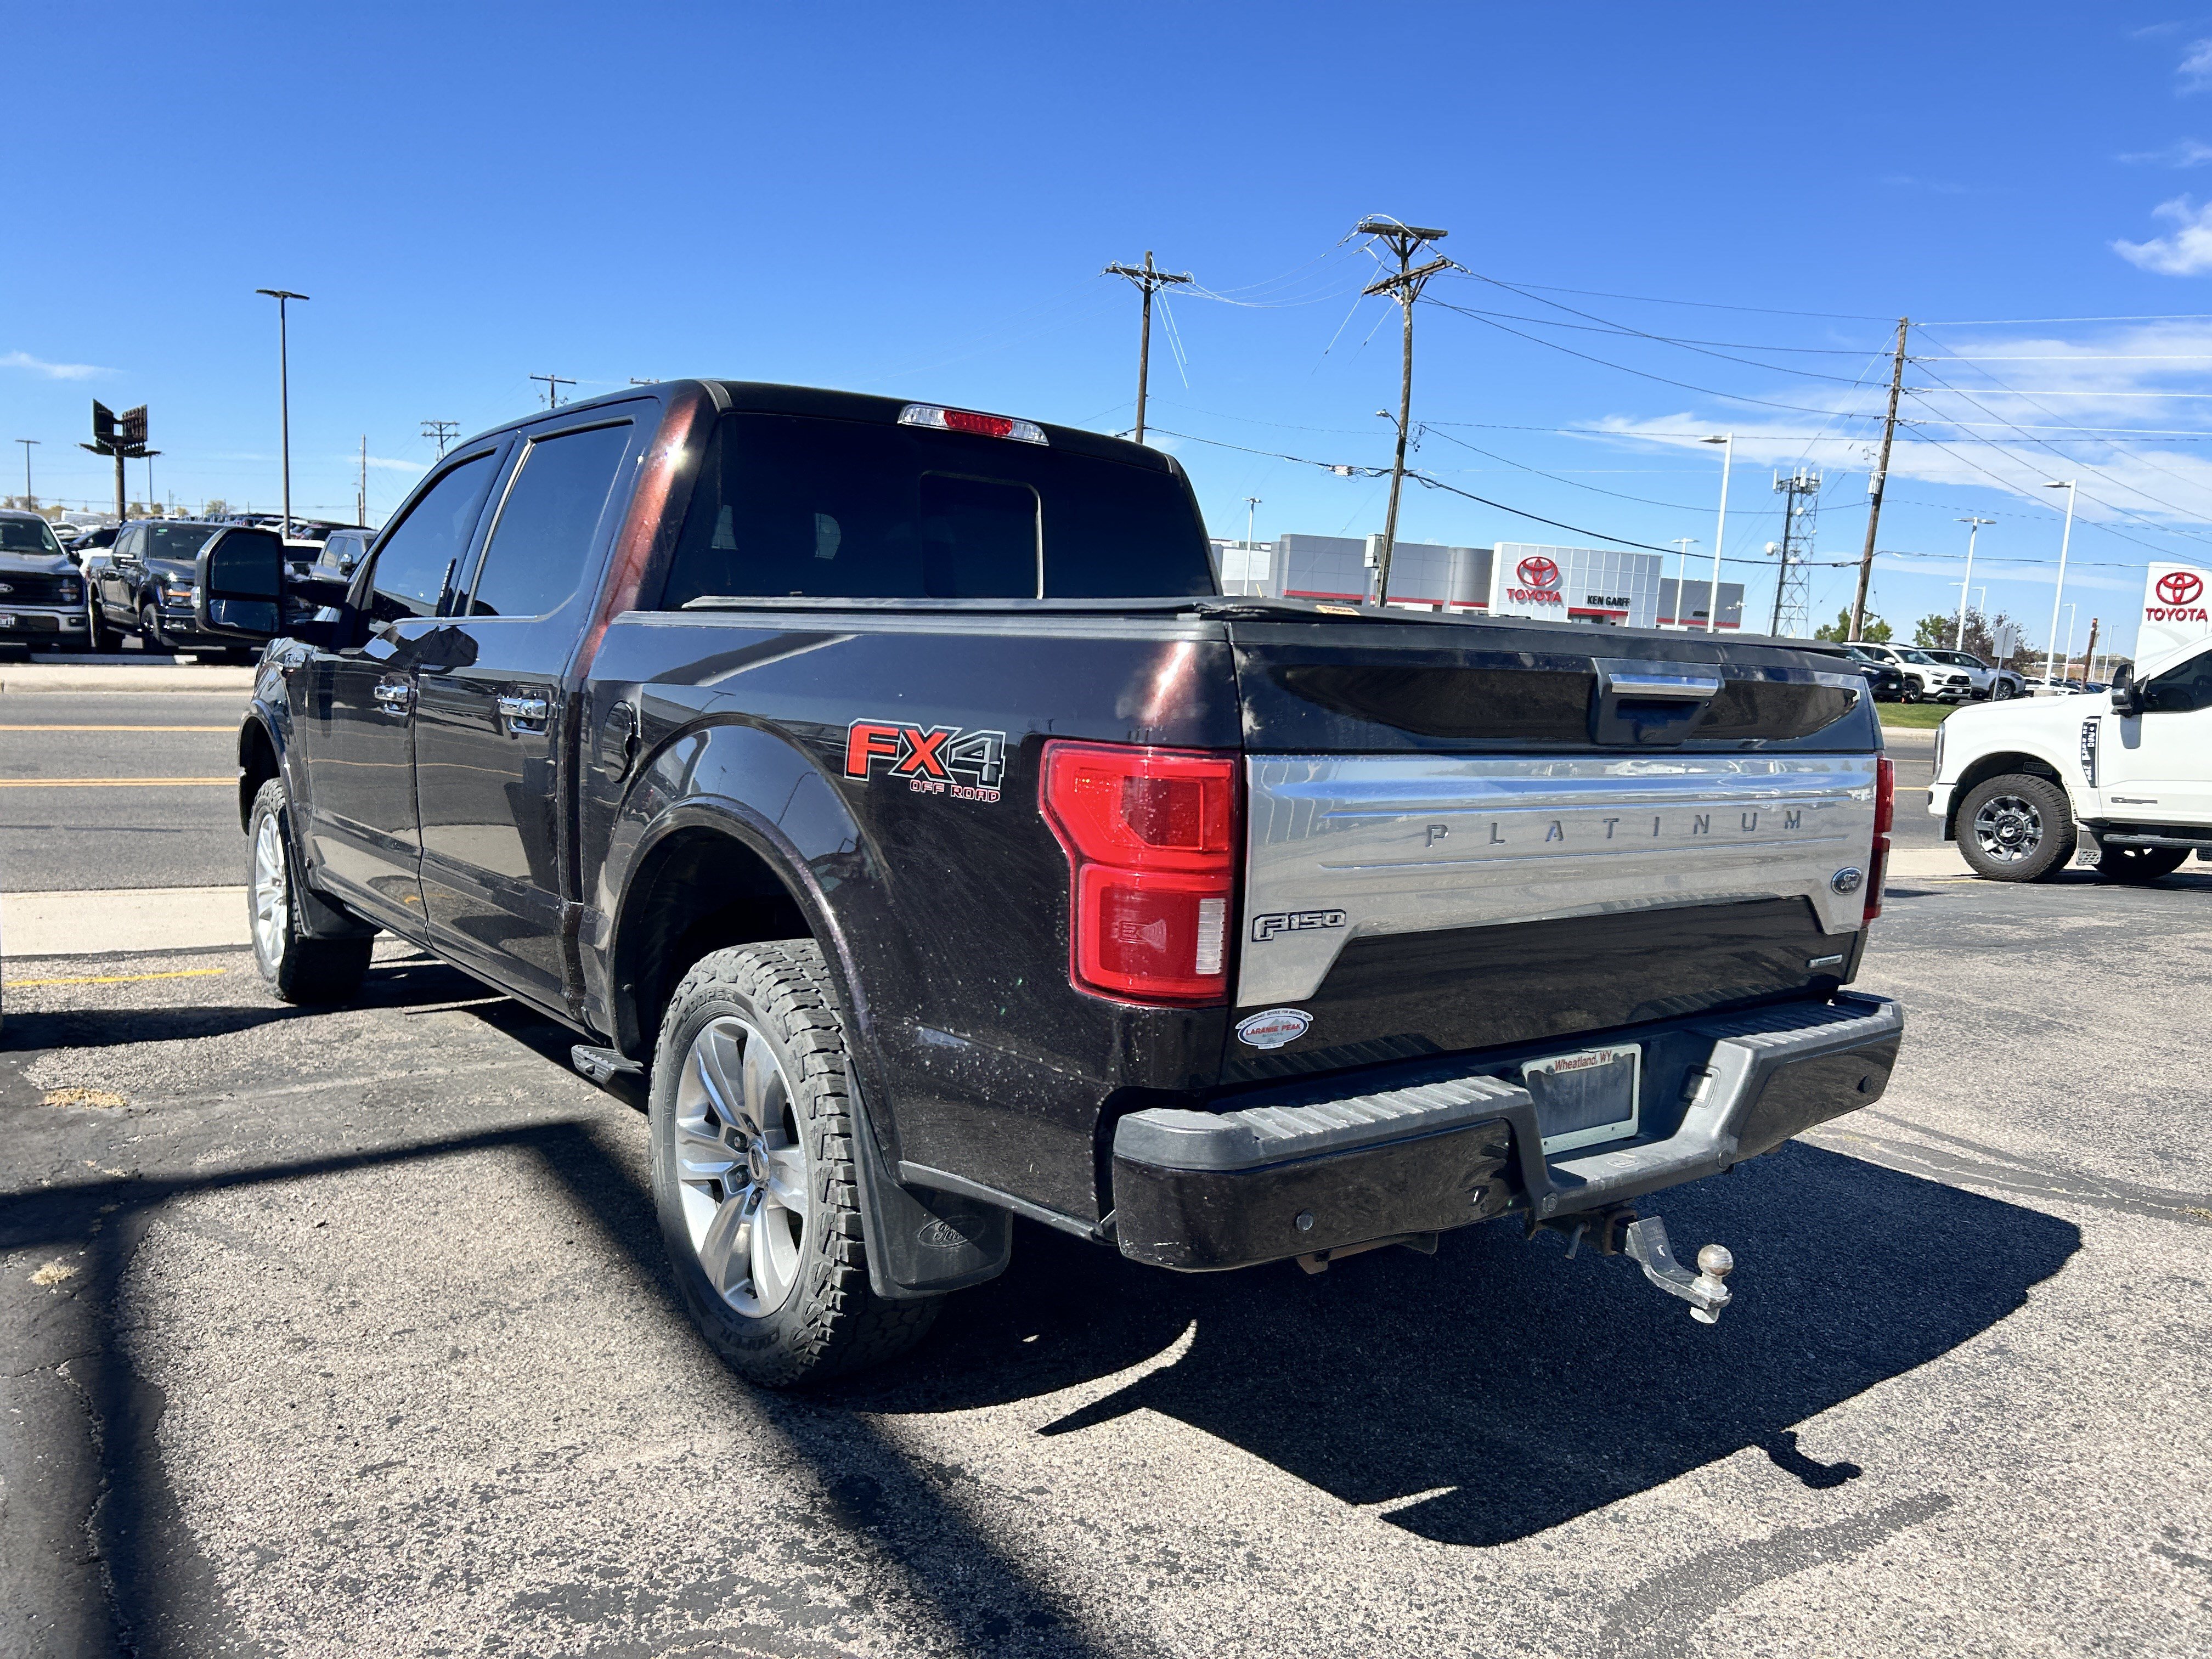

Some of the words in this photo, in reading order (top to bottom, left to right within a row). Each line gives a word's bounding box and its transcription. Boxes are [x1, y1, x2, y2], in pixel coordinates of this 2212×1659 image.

[1506, 589, 1561, 602] TOYOTA
[1587, 595, 1603, 606] KEN
[1606, 597, 1630, 607] GARFF
[2146, 608, 2208, 622] TOYOTA
[844, 718, 1006, 790] FX4
[910, 779, 945, 793] OFF
[950, 784, 1001, 803] ROAD
[1426, 810, 1801, 848] PLATINUM
[1246, 1025, 1279, 1036] LARAMIE
[1281, 1023, 1301, 1031] PEAK
[1600, 1049, 1612, 1063] WY
